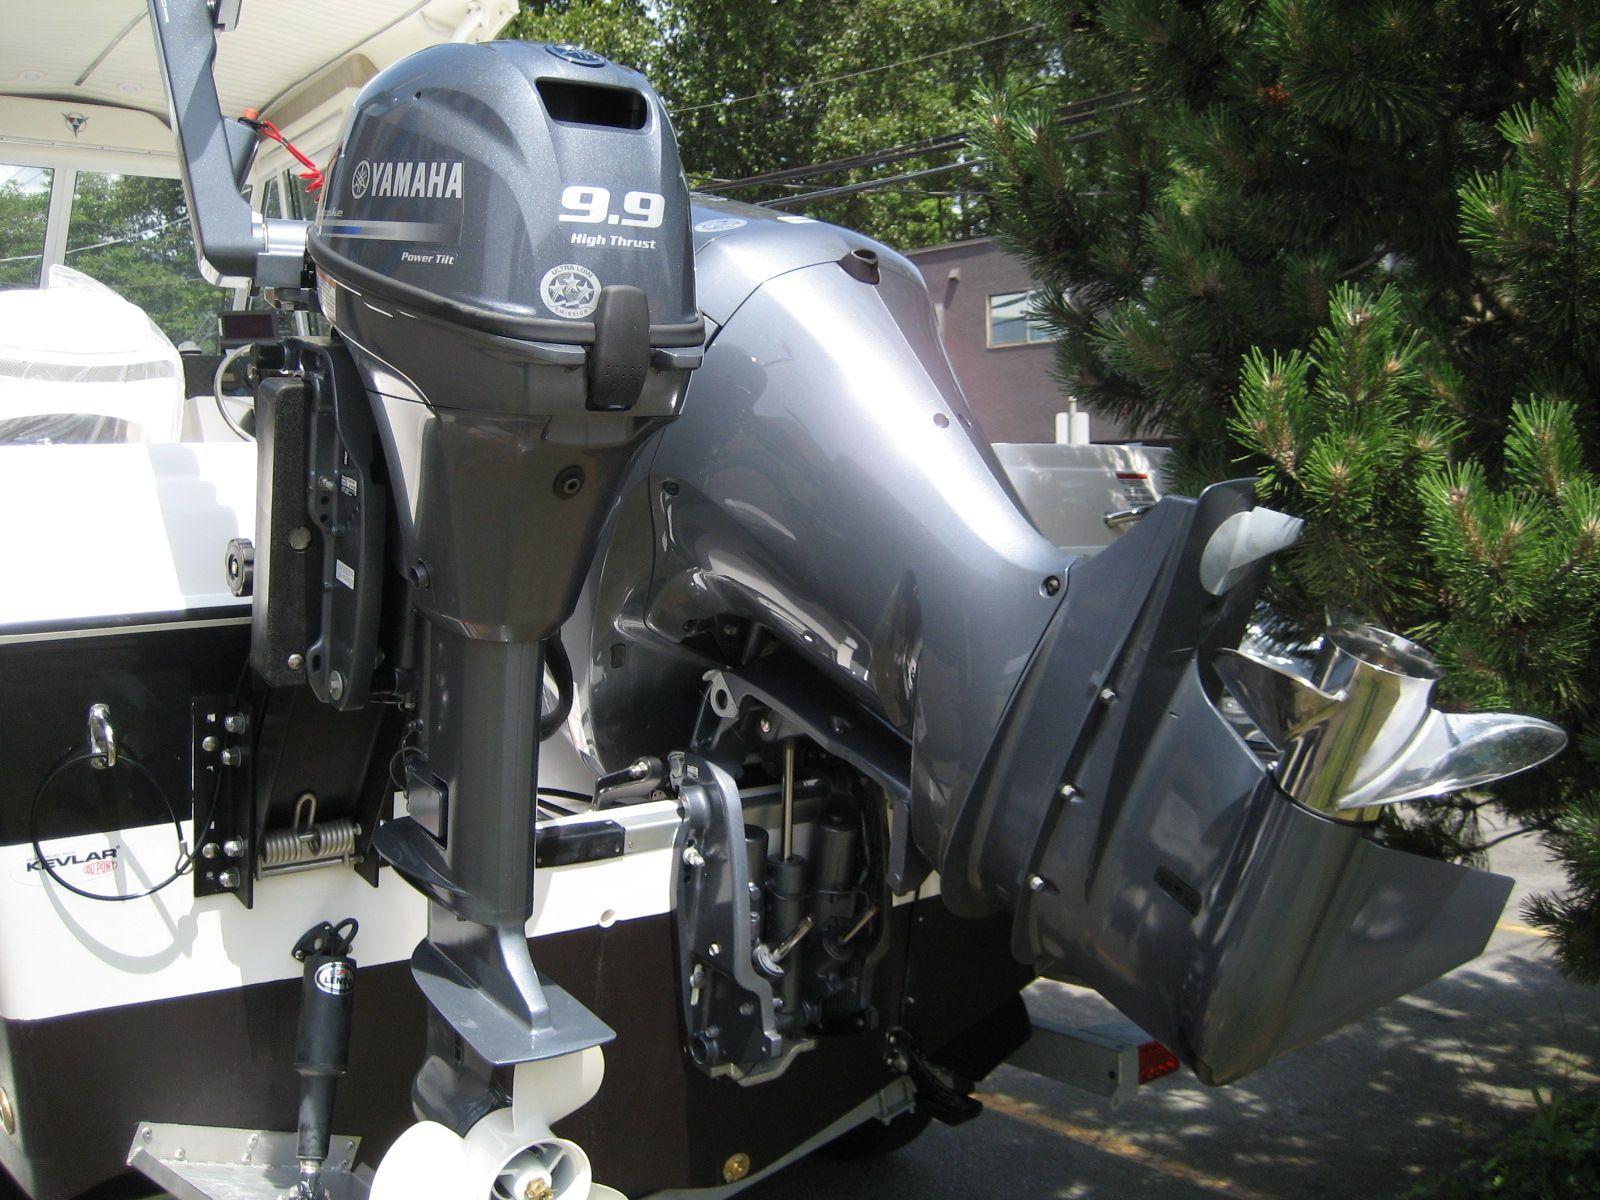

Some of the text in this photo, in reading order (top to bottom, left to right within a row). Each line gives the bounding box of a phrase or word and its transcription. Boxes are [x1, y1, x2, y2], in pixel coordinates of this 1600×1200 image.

[371, 162, 463, 199] YAMAHA
[559, 186, 665, 228] 9.9
[570, 233, 657, 249] High Thrust
[401, 251, 455, 265] Power Tilt
